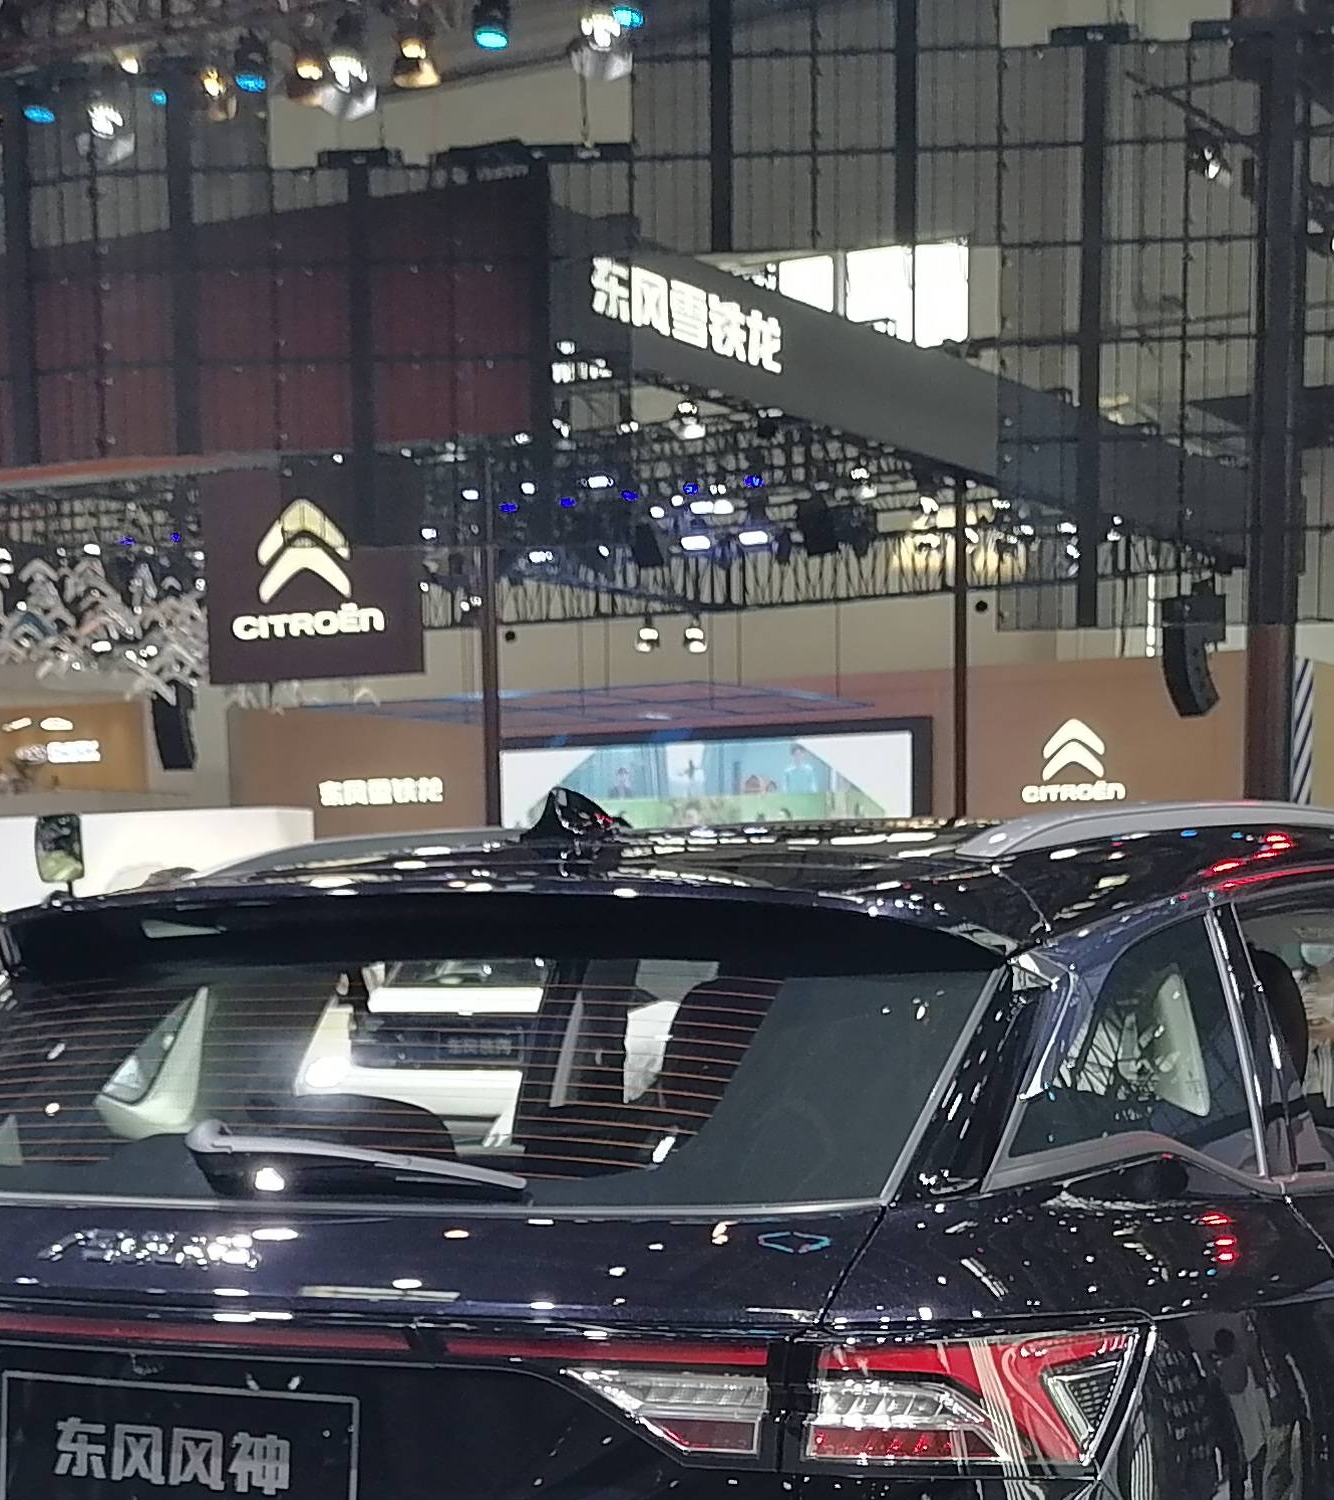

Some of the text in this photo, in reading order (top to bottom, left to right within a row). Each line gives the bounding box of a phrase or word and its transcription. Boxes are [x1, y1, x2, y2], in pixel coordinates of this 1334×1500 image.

[591, 256, 782, 374] 东风雪铁龙
[54, 1416, 290, 1495] 东风风神
